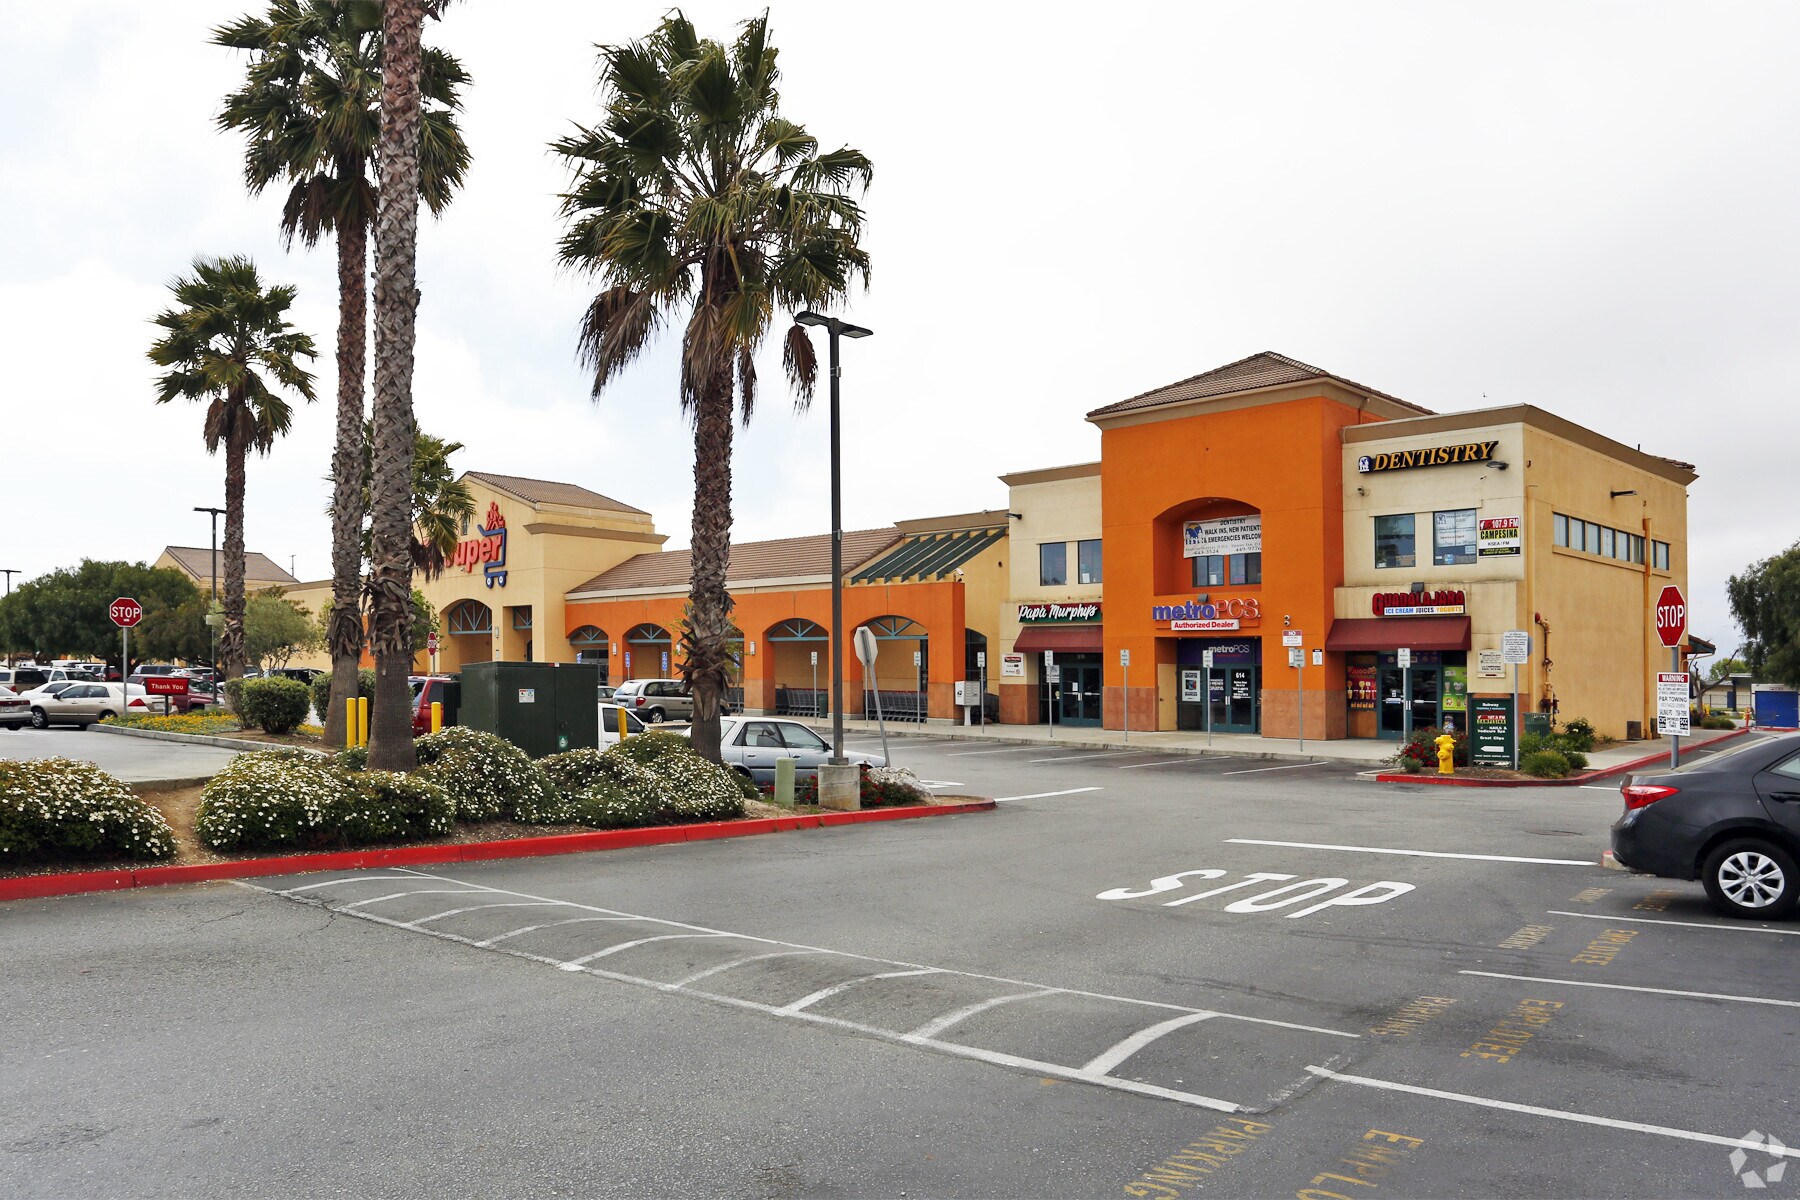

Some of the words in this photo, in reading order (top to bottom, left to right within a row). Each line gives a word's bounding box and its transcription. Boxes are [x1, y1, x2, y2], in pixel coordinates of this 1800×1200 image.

[1374, 441, 1496, 471] DENTISTRY
[1492, 519, 1508, 528] 107.9
[1509, 518, 1519, 527] FM
[1208, 535, 1240, 543] EMERGENCIES
[1481, 529, 1518, 540] CAMPESINA
[1372, 590, 1465, 616] GUADALAJARA
[111, 606, 140, 618] STOP
[1657, 604, 1684, 628] STOP
[1174, 621, 1210, 629] Authorized
[1208, 644, 1250, 654] metroPCS
[1661, 674, 1685, 683] WARNING
[1095, 869, 1416, 919] STOP
[1123, 1117, 1276, 1200] PARKING
